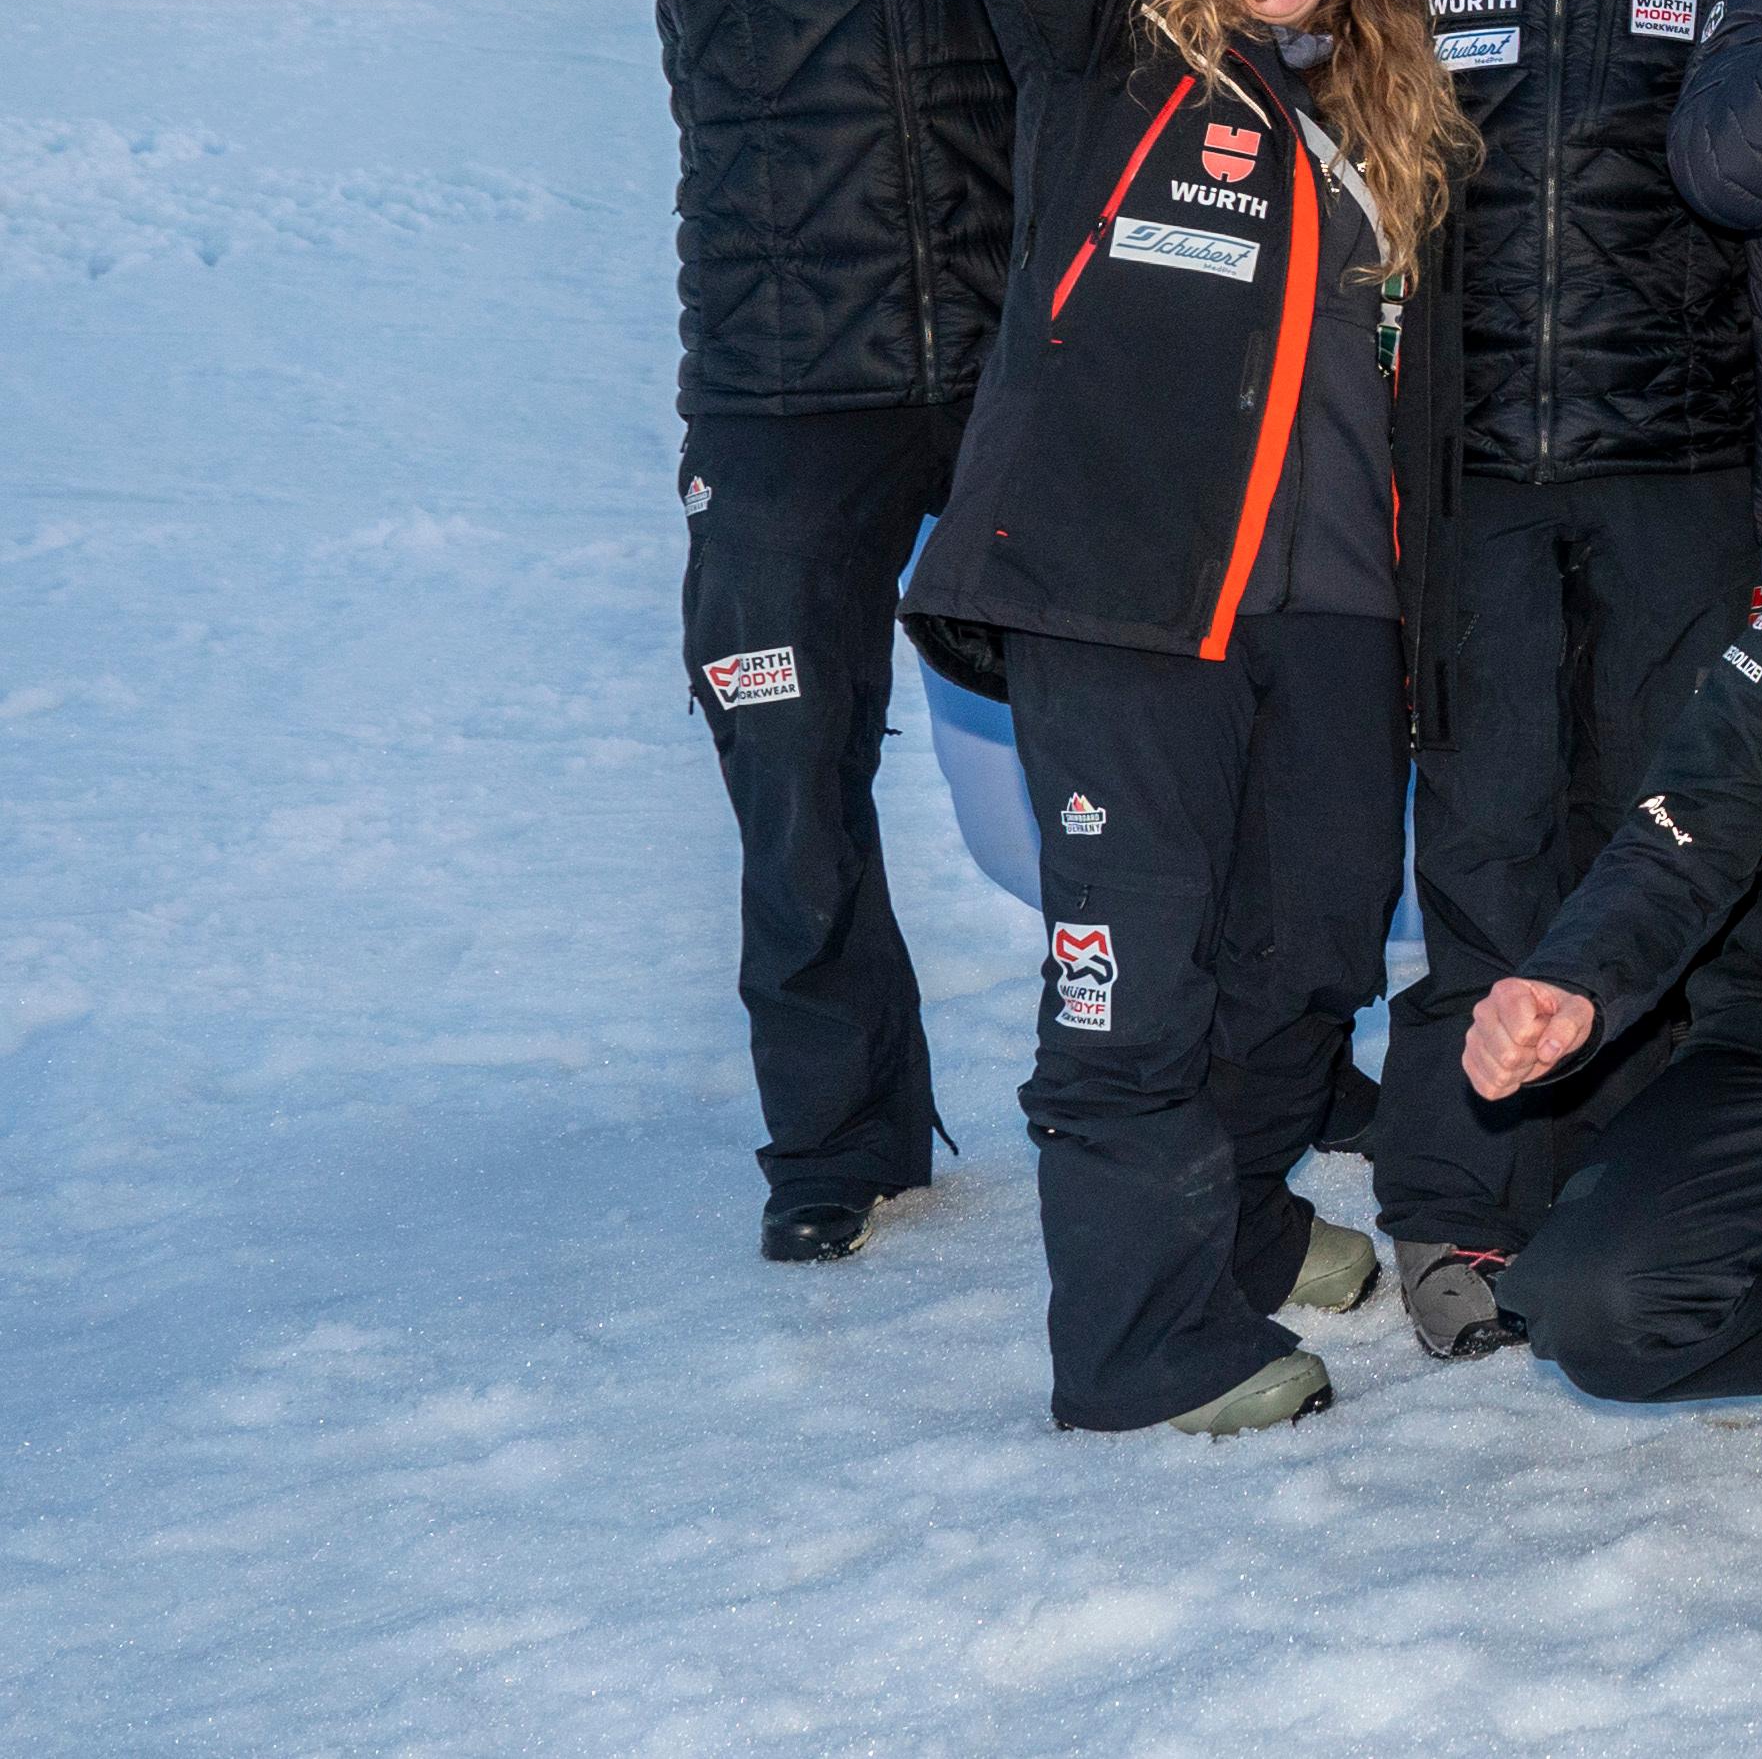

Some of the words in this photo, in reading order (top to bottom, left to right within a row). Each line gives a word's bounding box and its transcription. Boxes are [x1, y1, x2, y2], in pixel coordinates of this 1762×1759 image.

[1636, 8, 1692, 24] MODYF
[1636, 21, 1690, 35] WORKWEAR
[1117, 230, 1256, 267] Schubert
[741, 652, 791, 672] ÜRTH
[740, 668, 792, 687] ODYF
[739, 684, 796, 700] ORKWEAR
